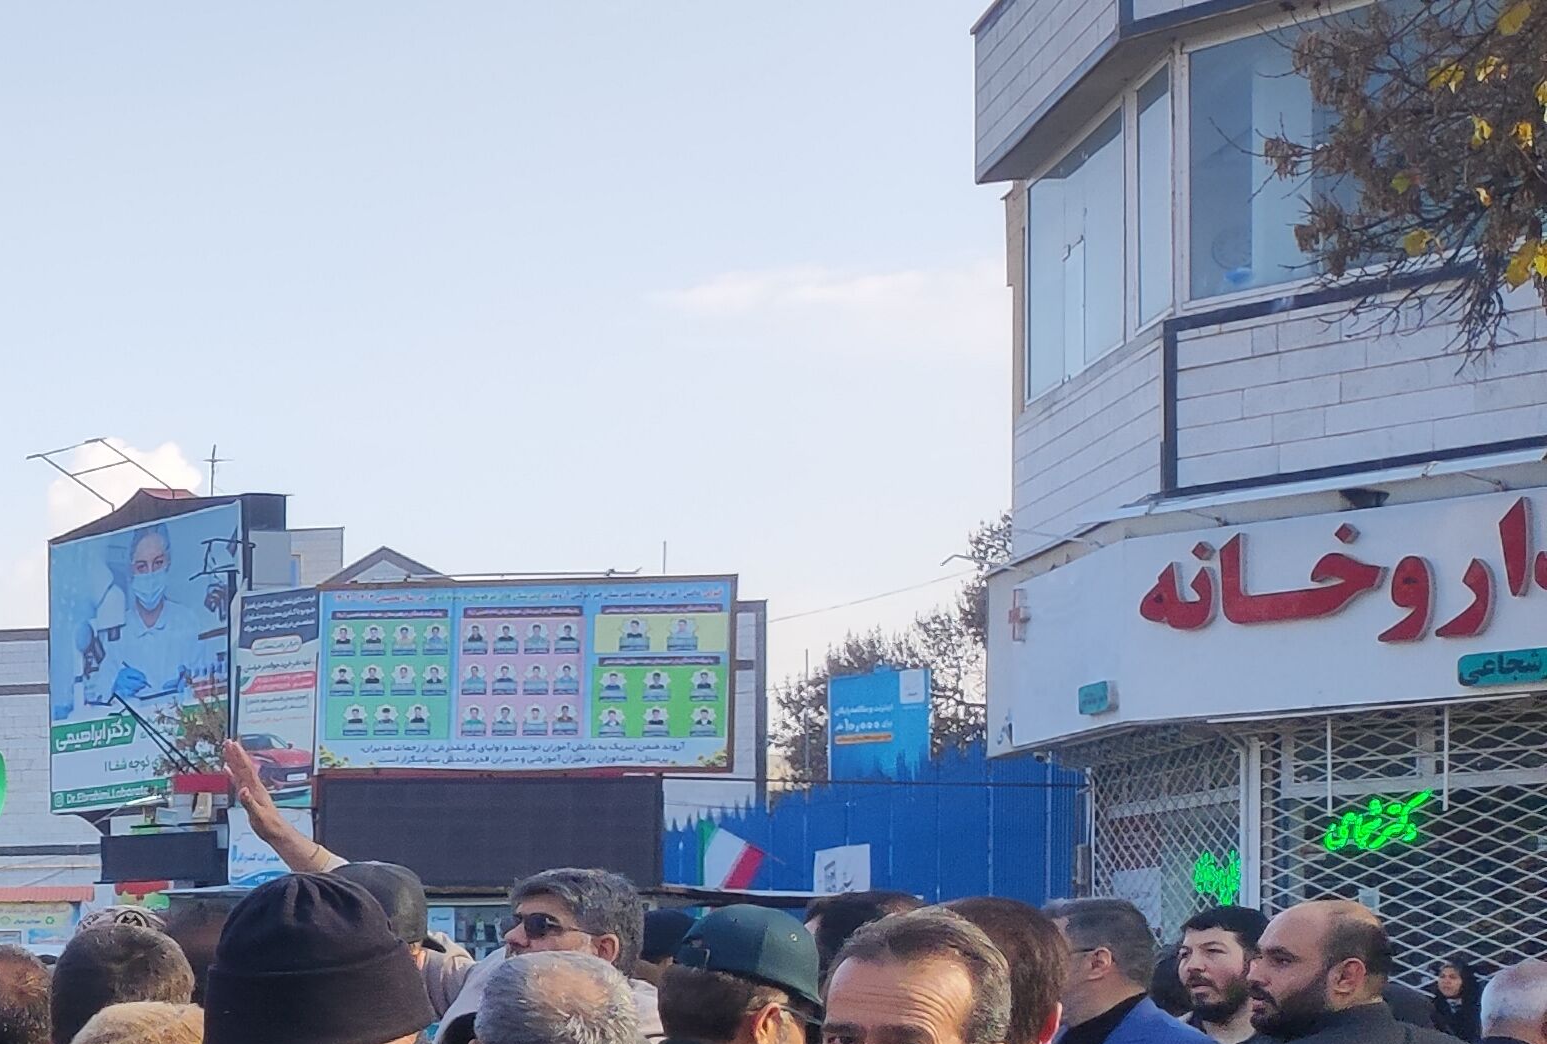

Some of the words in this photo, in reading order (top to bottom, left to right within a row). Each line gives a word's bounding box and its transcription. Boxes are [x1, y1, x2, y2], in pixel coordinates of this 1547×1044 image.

[1139, 497, 1547, 643] اروخانه
[1458, 653, 1542, 687] شجاعی
[55, 722, 107, 752] ابراهیمی
[106, 717, 132, 744] دکتر
[108, 757, 127, 772] شفا
[128, 756, 150, 772] کوچه
